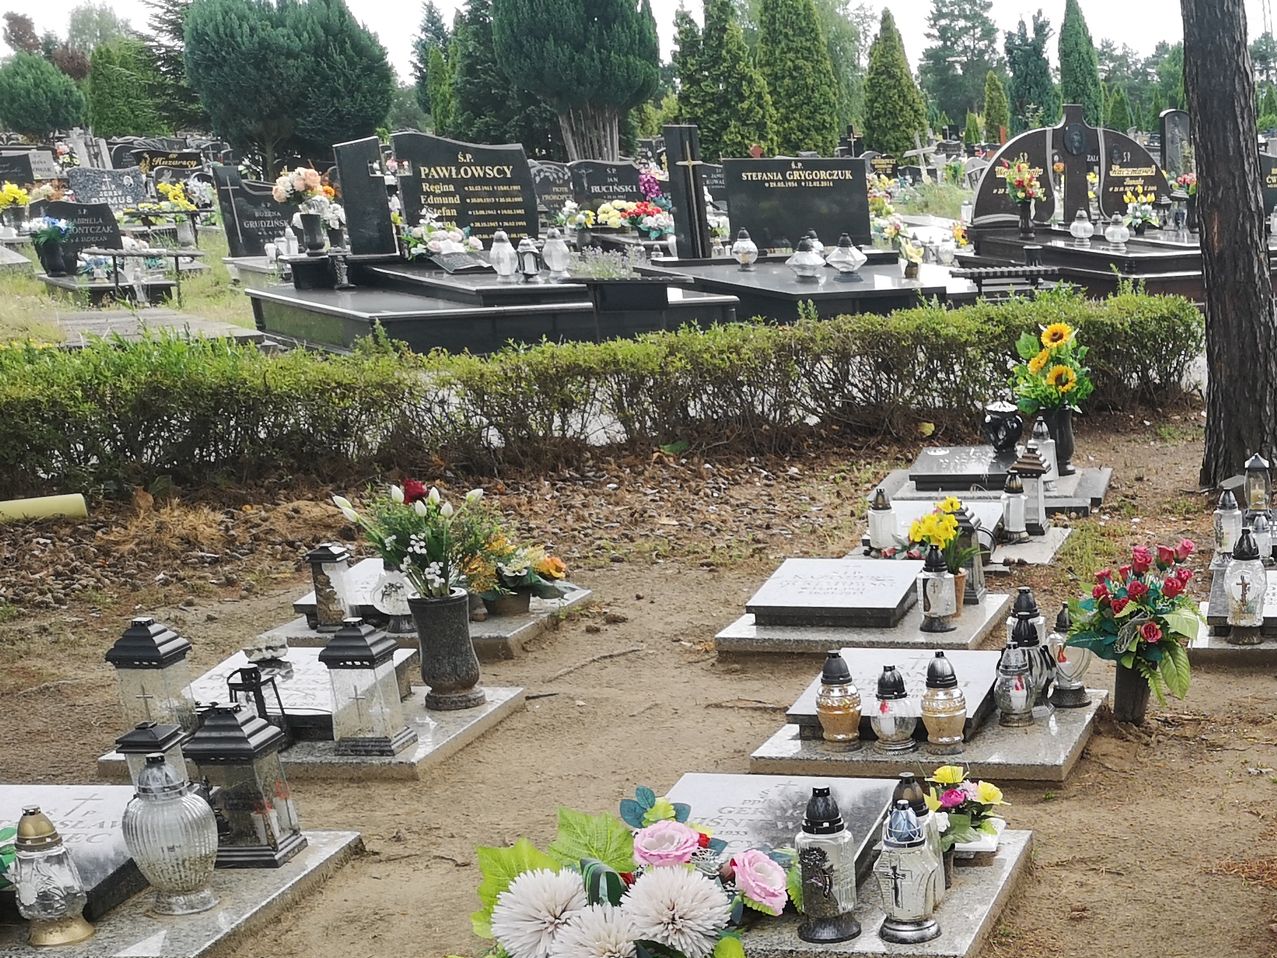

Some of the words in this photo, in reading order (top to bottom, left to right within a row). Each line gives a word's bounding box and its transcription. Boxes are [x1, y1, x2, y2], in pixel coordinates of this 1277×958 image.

[420, 165, 512, 179] PAWŁOWSCY
[742, 172, 783, 181] STEFANIA
[785, 170, 853, 180] GRYGORCZUK
[422, 182, 455, 195] Regina
[591, 183, 637, 193] RUCIŃSKI
[420, 195, 460, 204] Edmund
